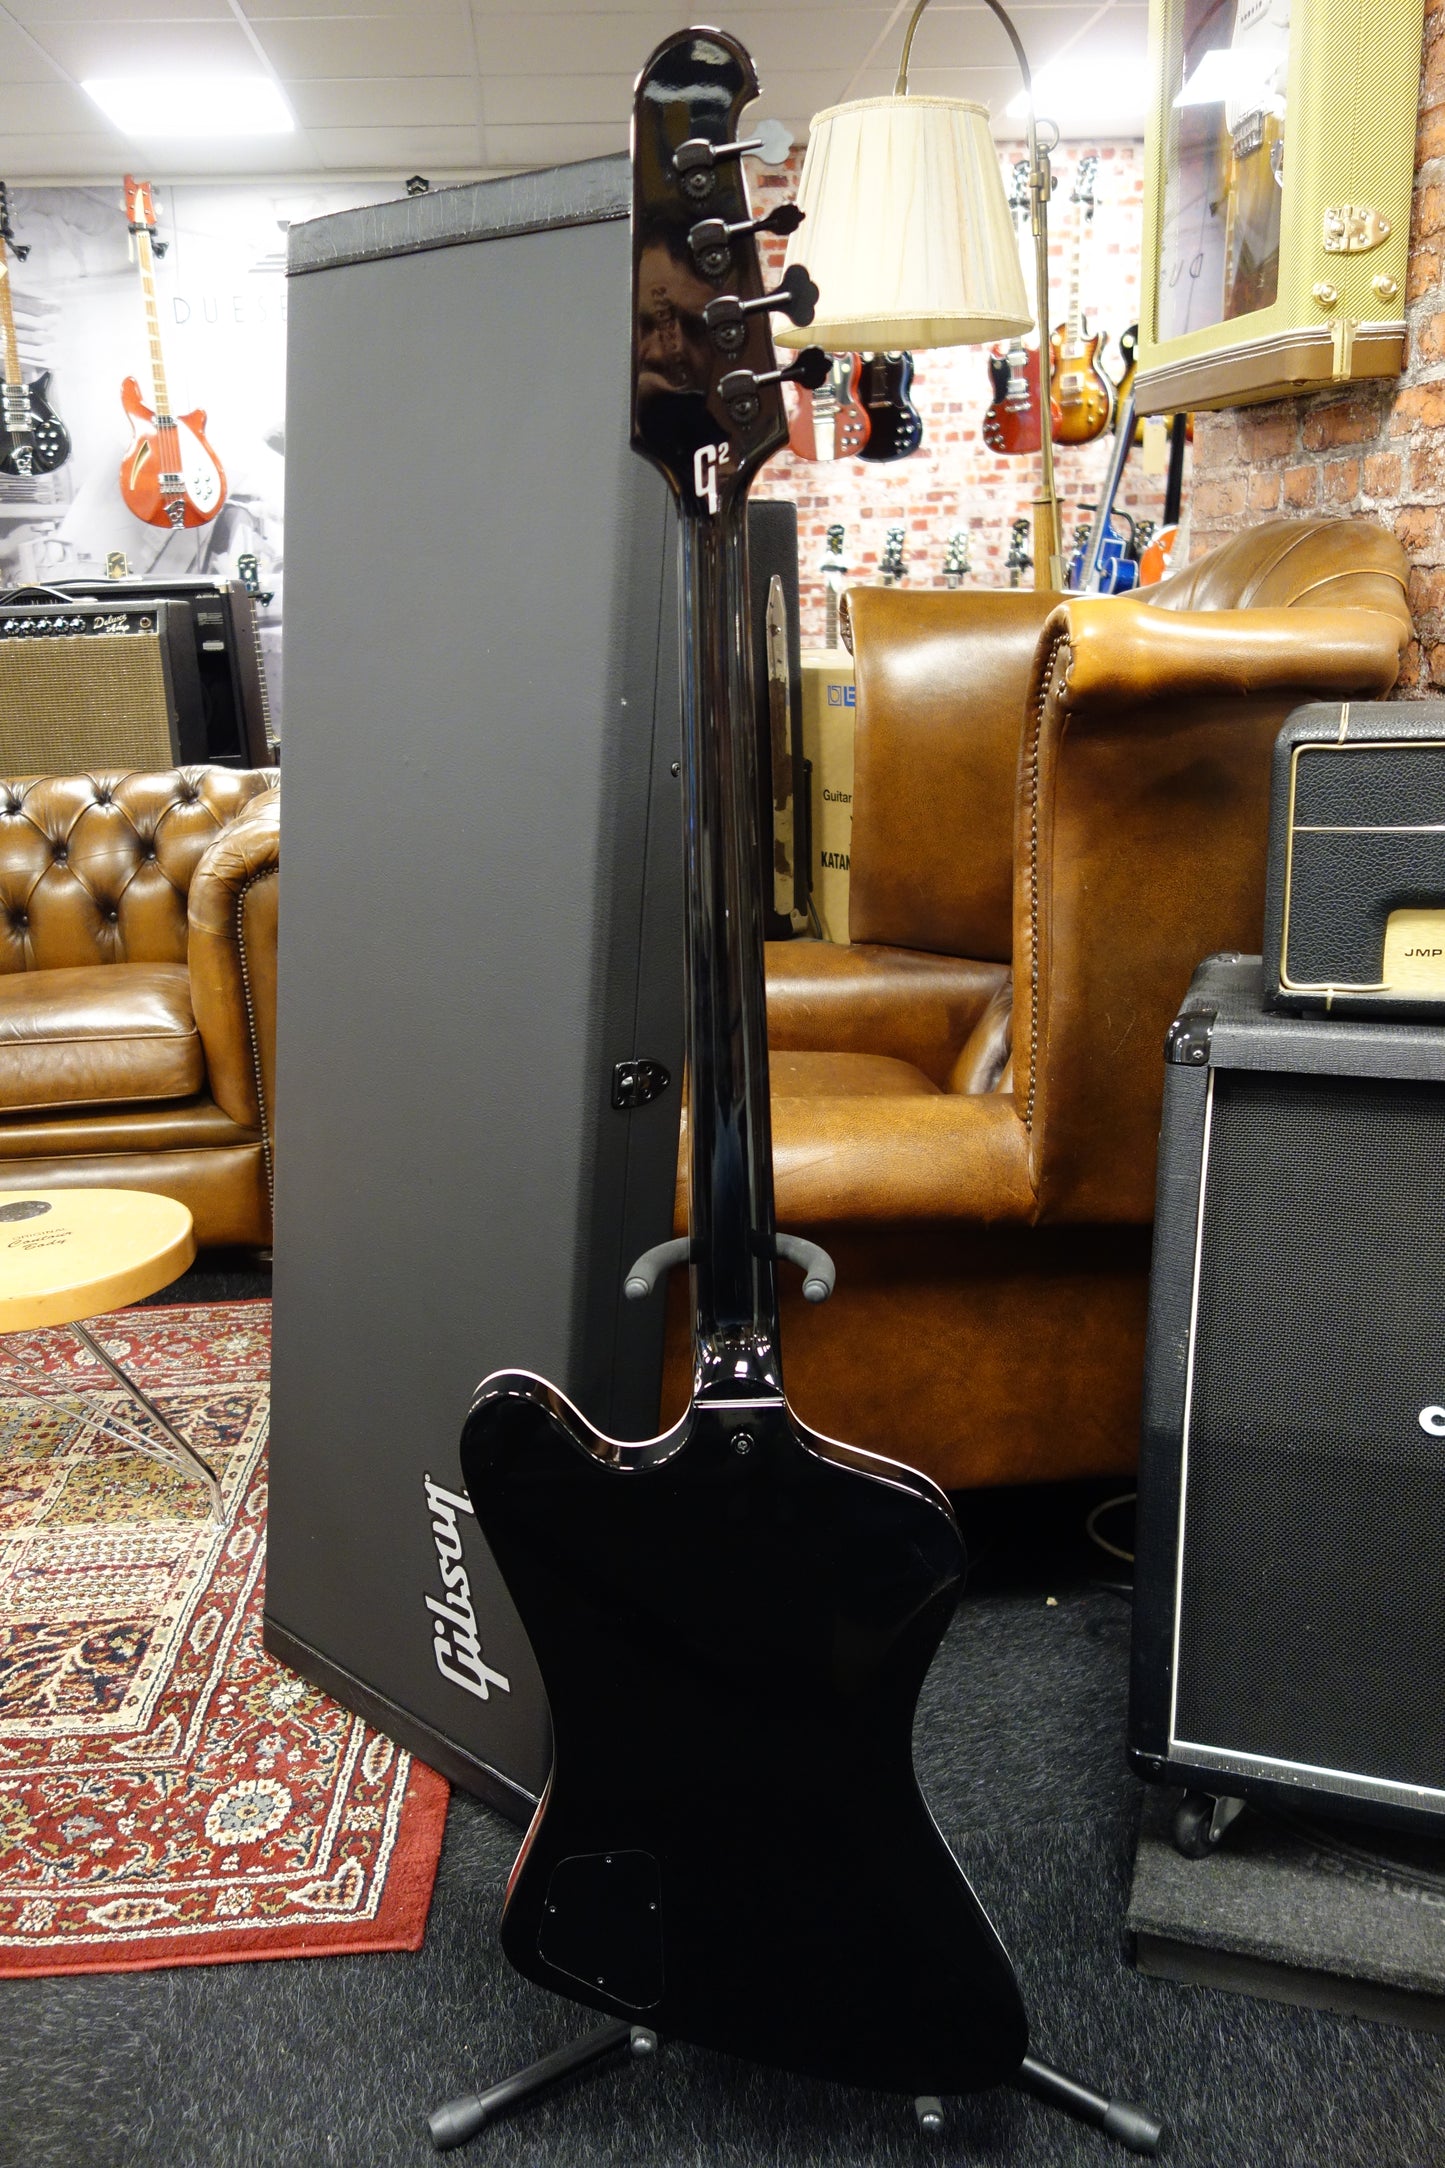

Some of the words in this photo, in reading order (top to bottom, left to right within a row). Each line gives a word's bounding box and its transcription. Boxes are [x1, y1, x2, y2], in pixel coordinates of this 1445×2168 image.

[93, 613, 128, 630] Deluxe
[106, 622, 130, 633] Amp
[823, 788, 853, 803] Guitar
[1404, 948, 1443, 957] JMP
[424, 1478, 511, 1700] Gibson
